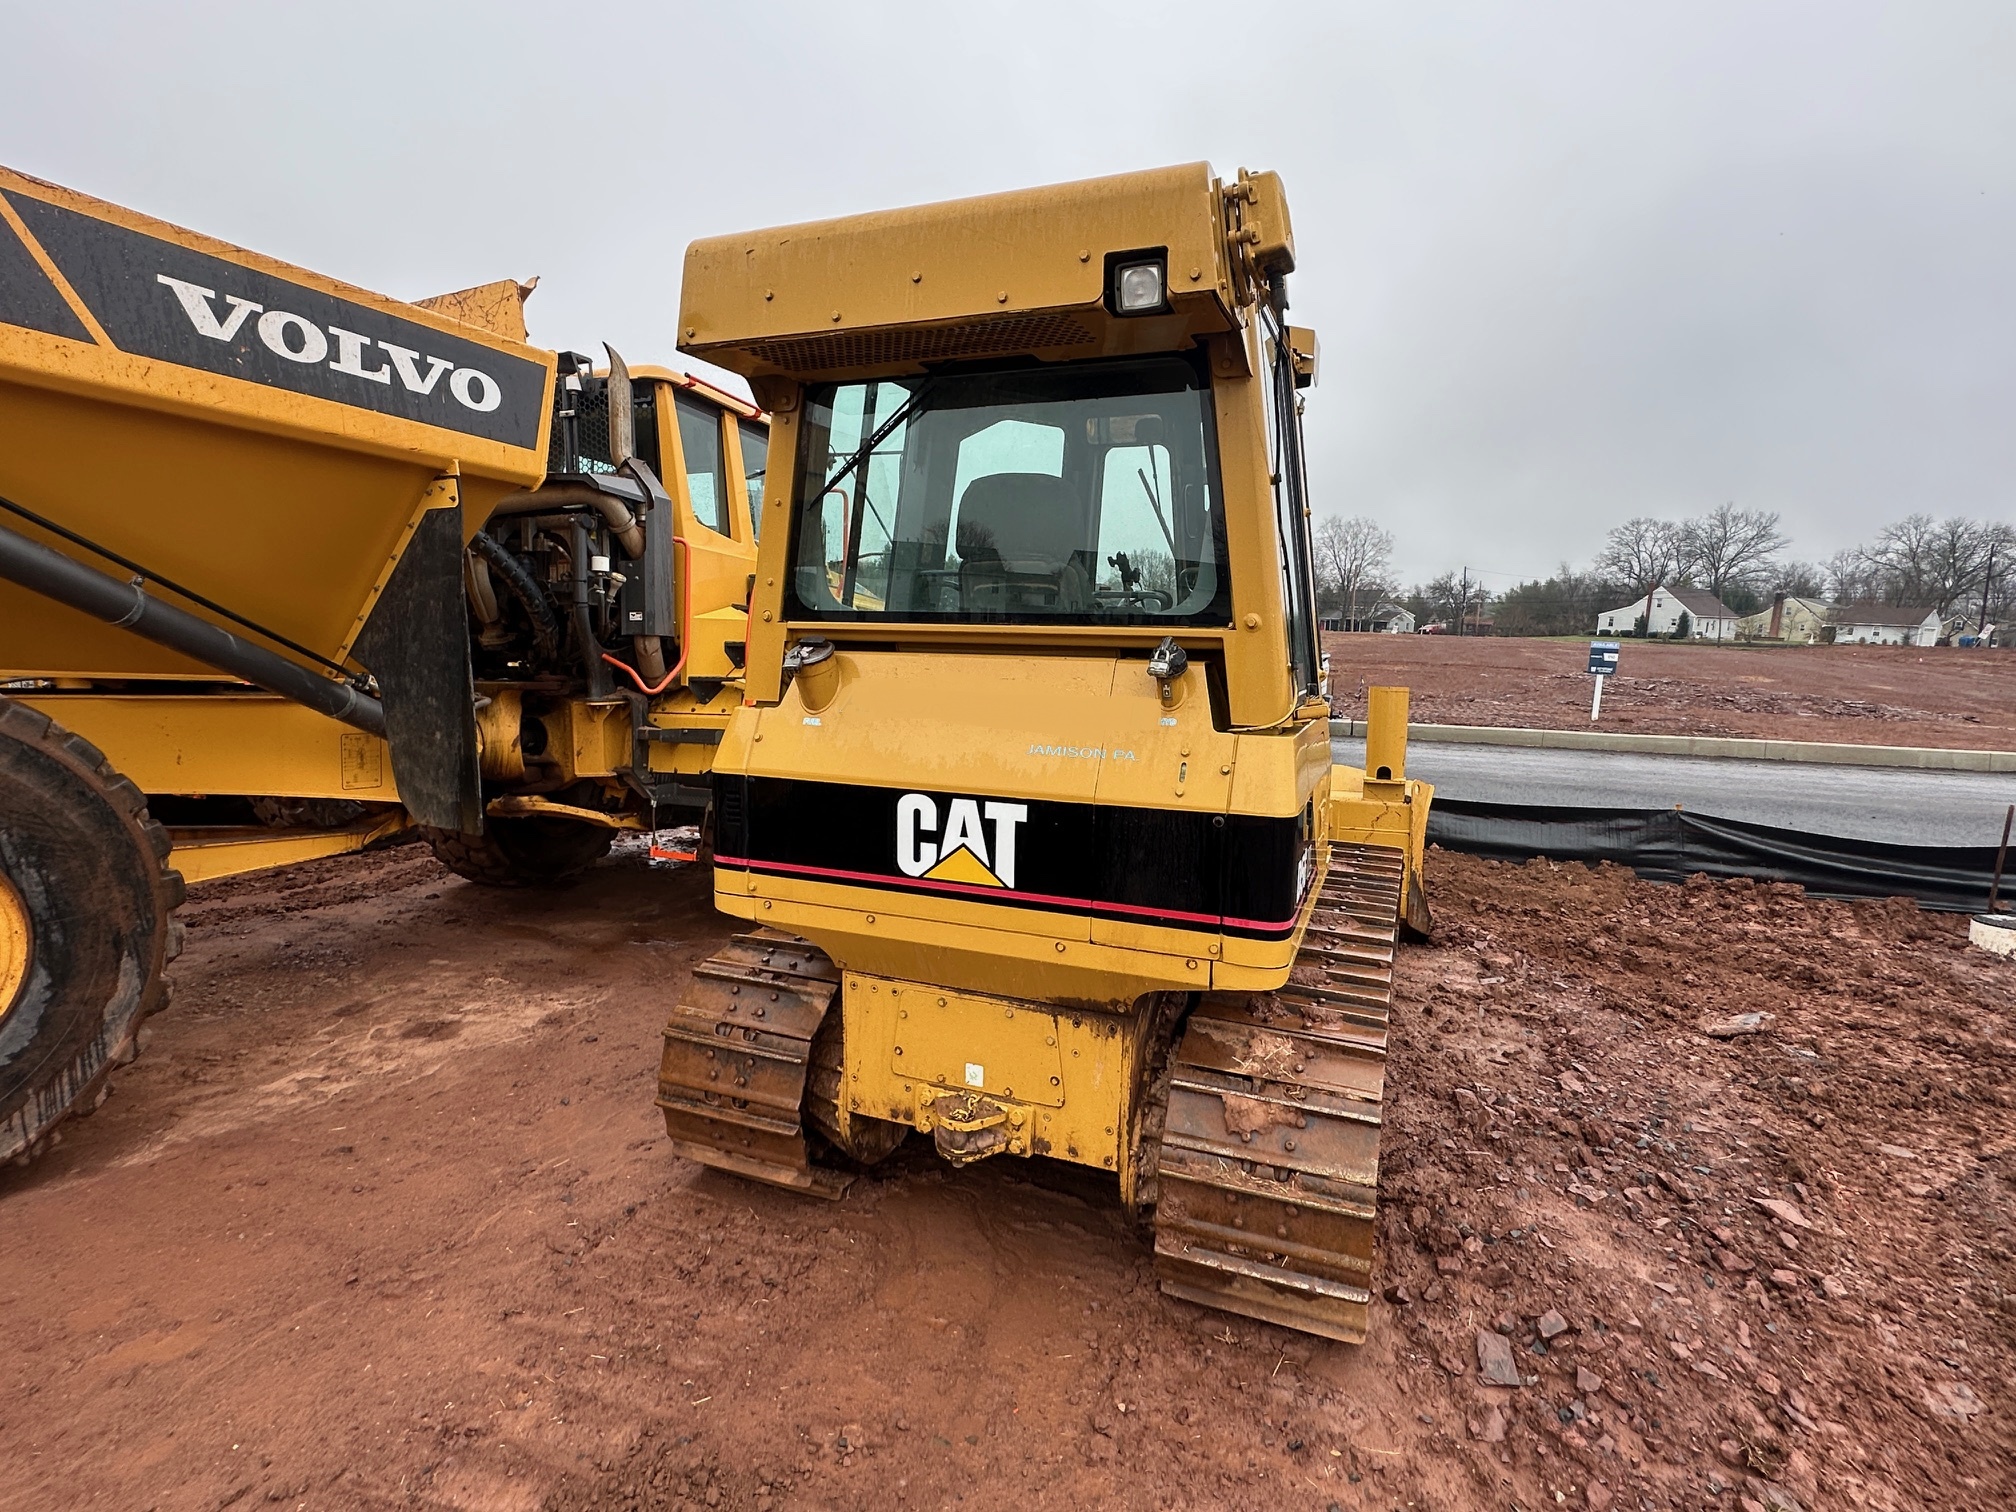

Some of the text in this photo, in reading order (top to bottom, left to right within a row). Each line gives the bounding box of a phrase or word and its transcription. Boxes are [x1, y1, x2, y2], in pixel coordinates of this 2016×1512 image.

[157, 275, 502, 412] VOLVO
[1026, 744, 1107, 760] JAMISON
[897, 793, 1028, 889] CAT
